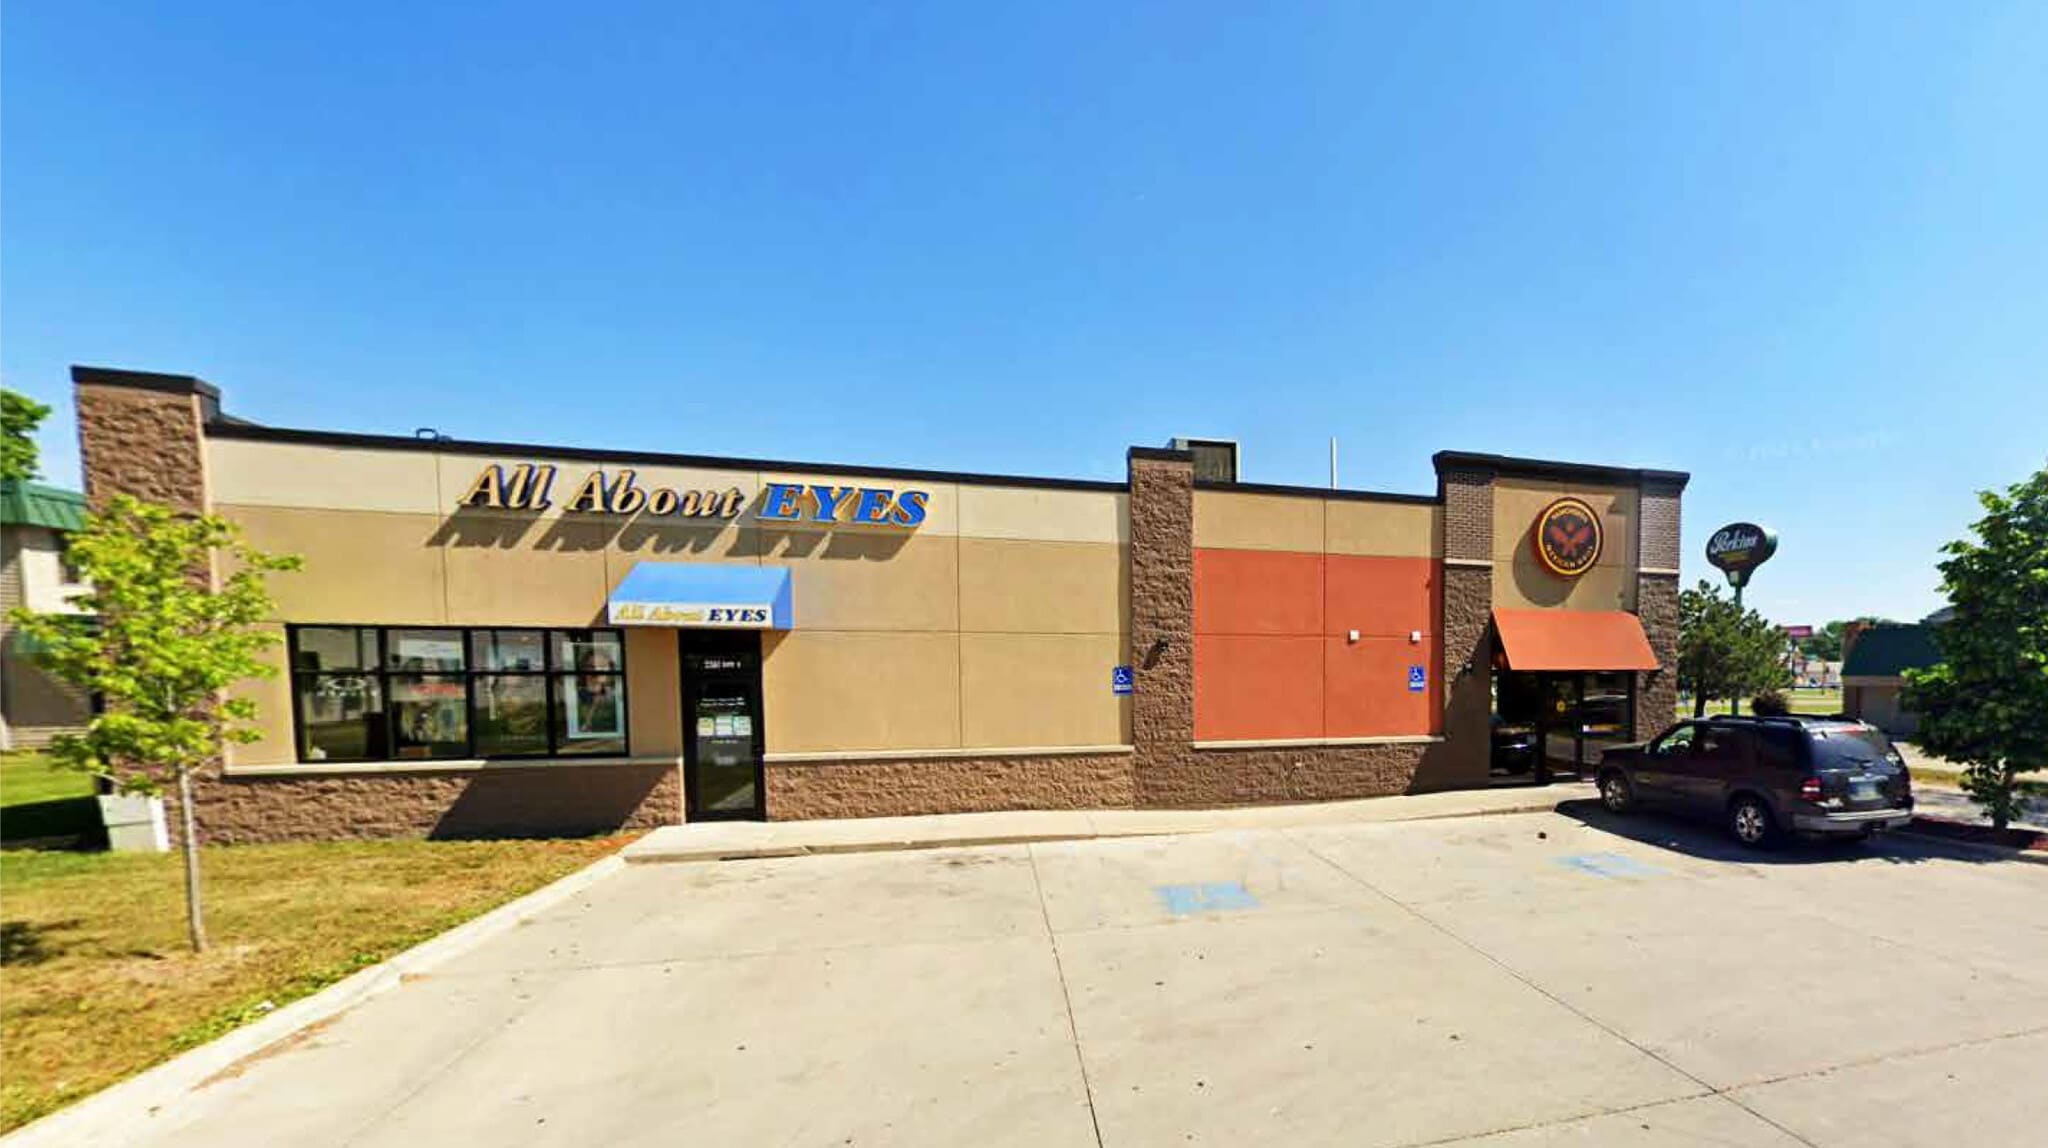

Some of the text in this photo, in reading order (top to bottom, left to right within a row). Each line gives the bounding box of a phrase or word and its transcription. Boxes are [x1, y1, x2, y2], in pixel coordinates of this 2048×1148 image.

[457, 463, 929, 526] All About EYES
[709, 608, 767, 622] EYES
